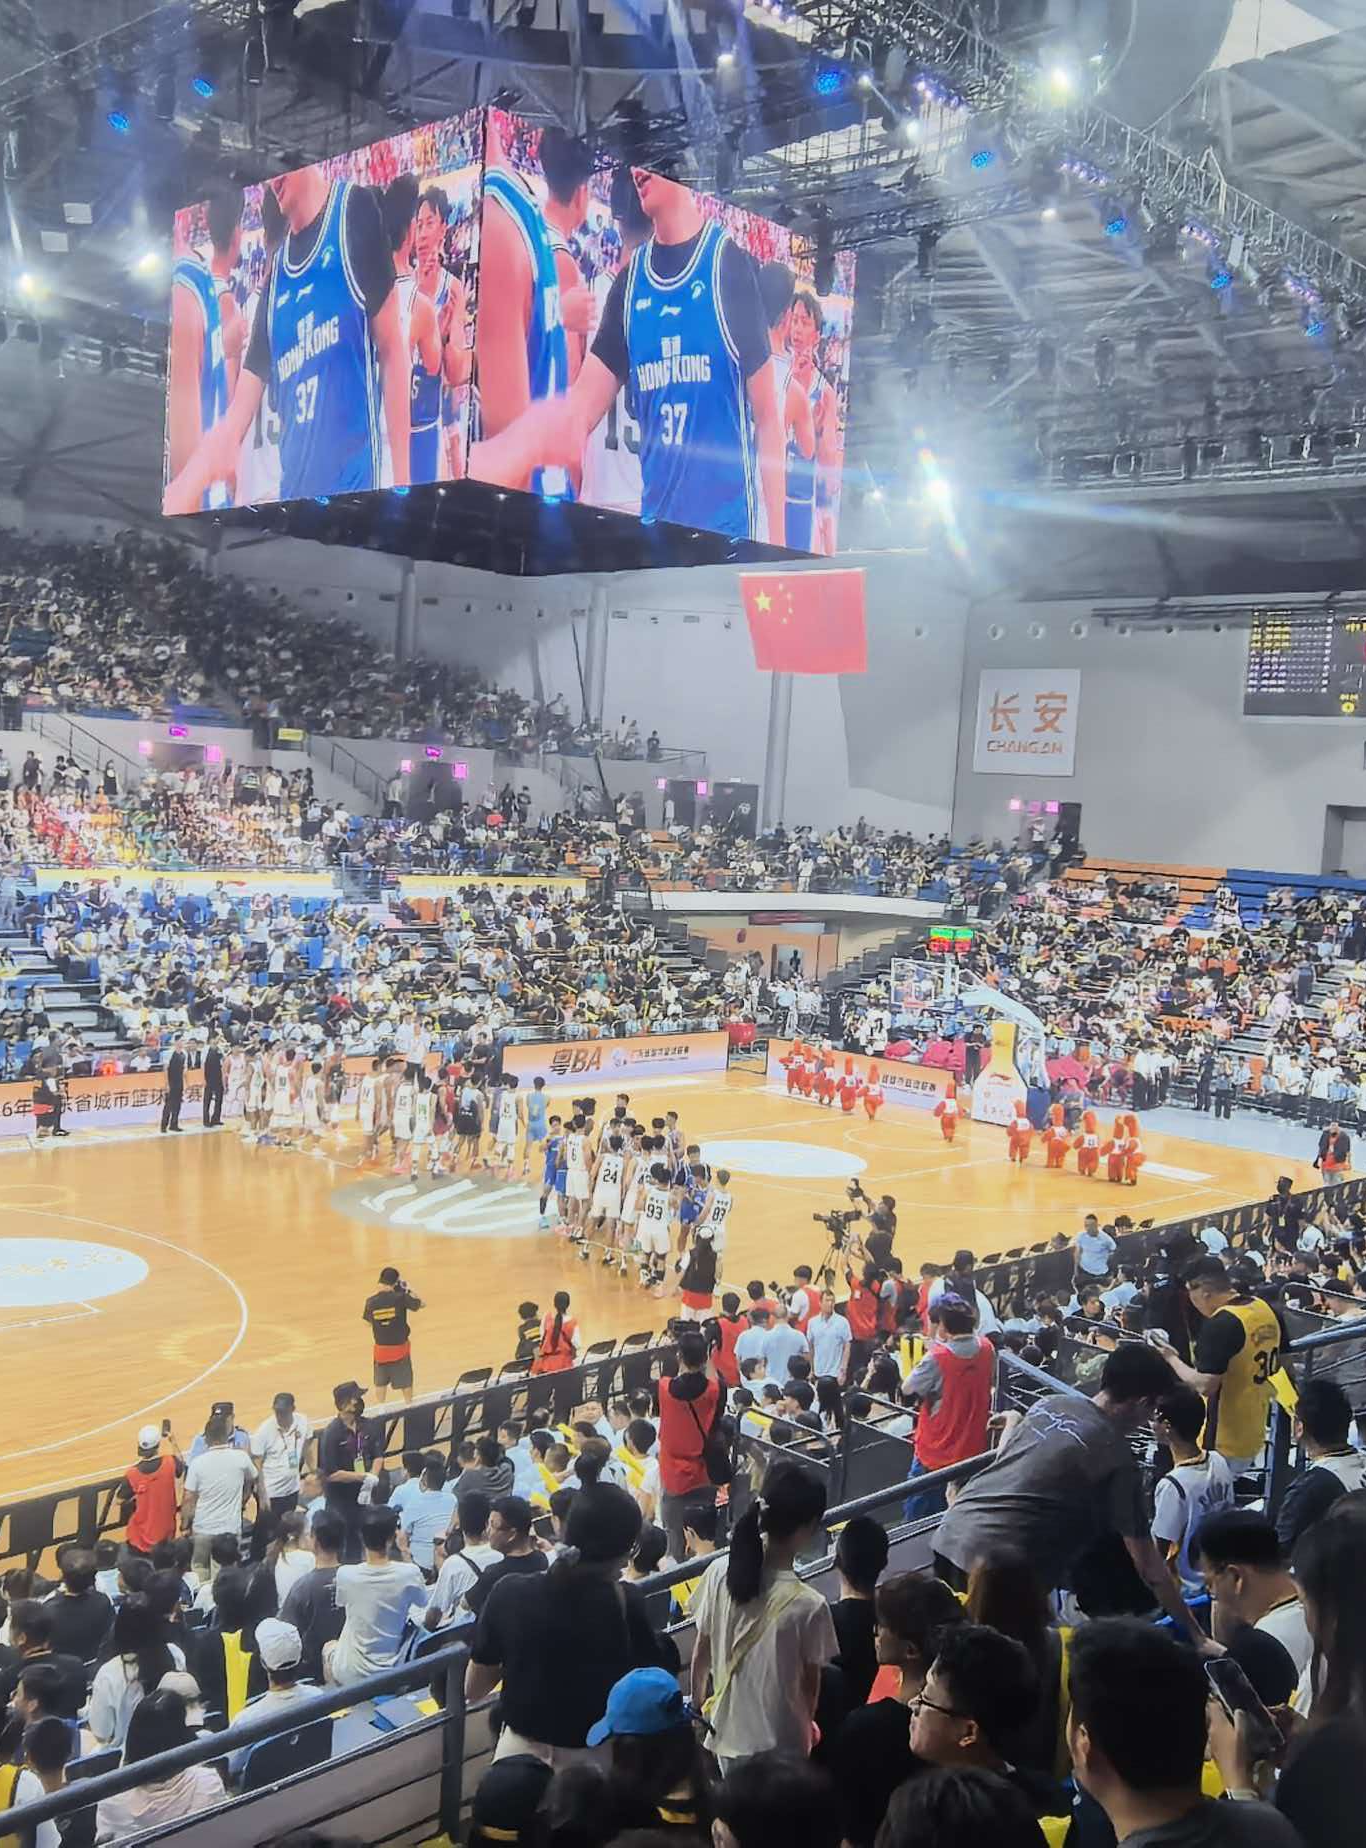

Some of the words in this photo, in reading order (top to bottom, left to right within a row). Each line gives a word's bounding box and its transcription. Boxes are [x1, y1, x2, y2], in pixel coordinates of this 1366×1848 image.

[277, 340, 305, 384] HONG
[305, 315, 340, 360] KONG
[636, 358, 671, 392] HONG
[671, 353, 712, 384] KONG
[295, 374, 319, 424] 37
[659, 402, 688, 446] 37
[987, 688, 1068, 734] 长安
[602, 1168, 618, 1185] 24
[1253, 1346, 1279, 1385] 30
